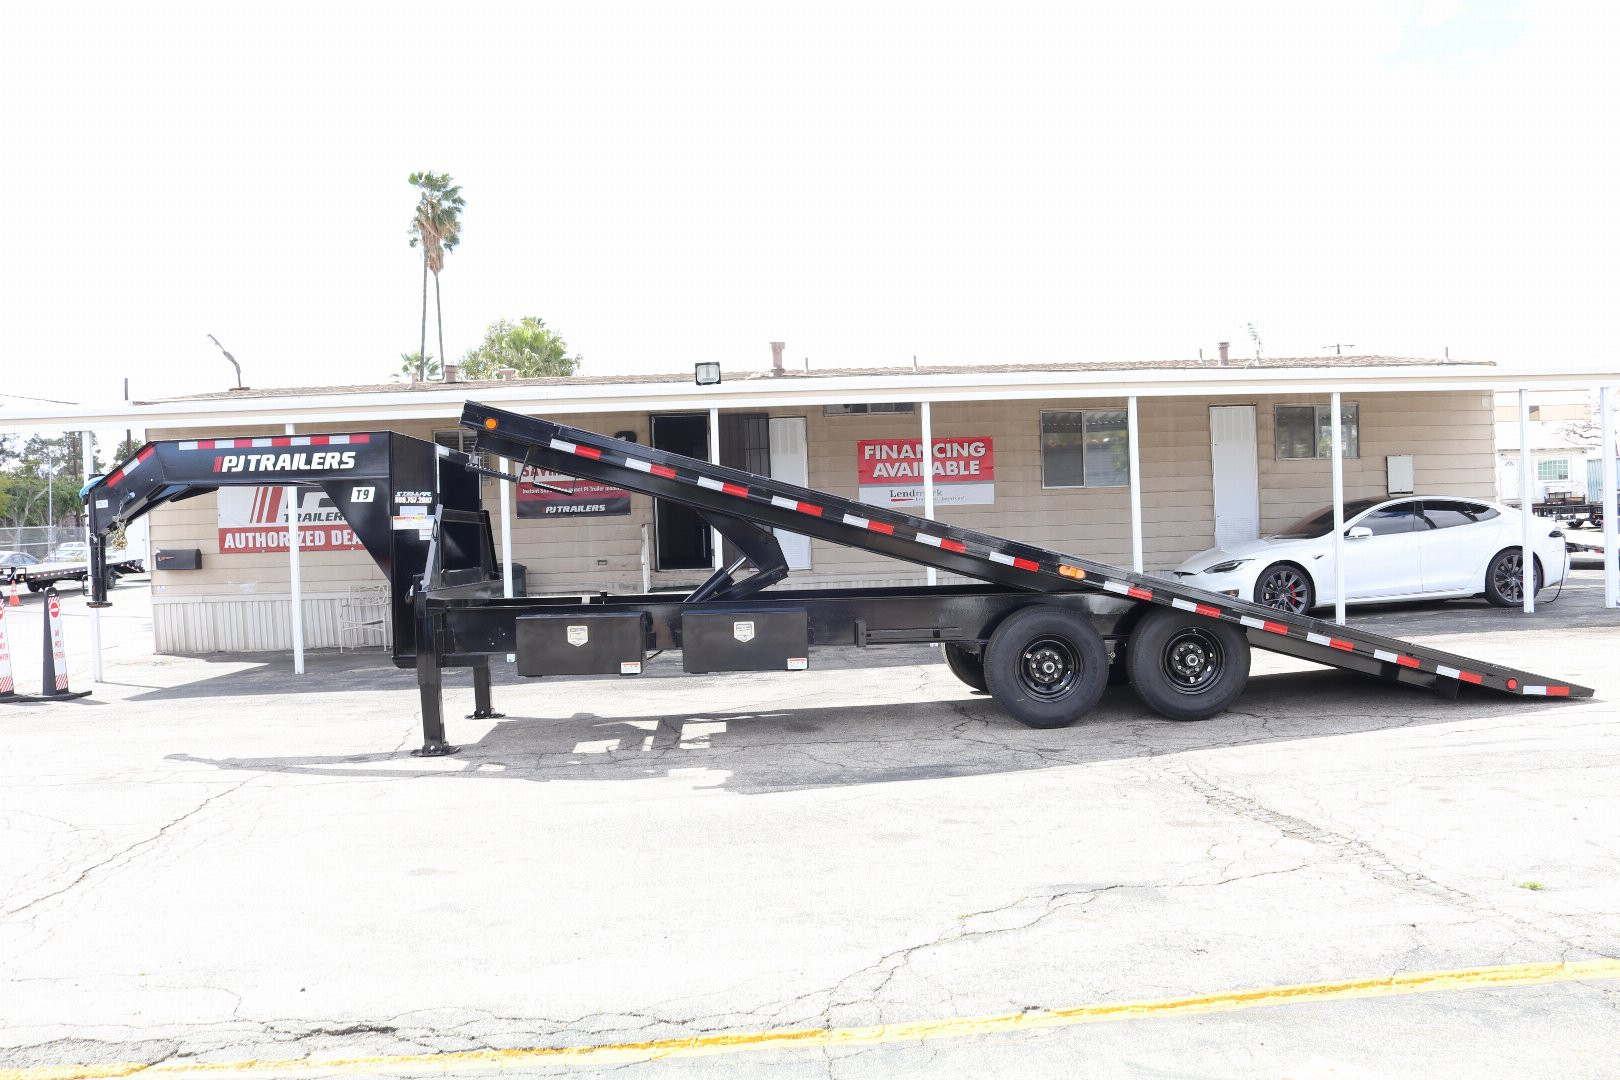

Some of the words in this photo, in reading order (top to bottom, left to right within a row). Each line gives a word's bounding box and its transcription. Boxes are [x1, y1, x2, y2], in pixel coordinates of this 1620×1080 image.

[221, 455, 246, 473] PJ
[247, 451, 357, 472] TRAILERS
[356, 489, 370, 500] T9
[889, 489, 943, 498] Lendmrk
[557, 504, 606, 513] TRAILERS
[224, 530, 326, 549] AUTHORZED
